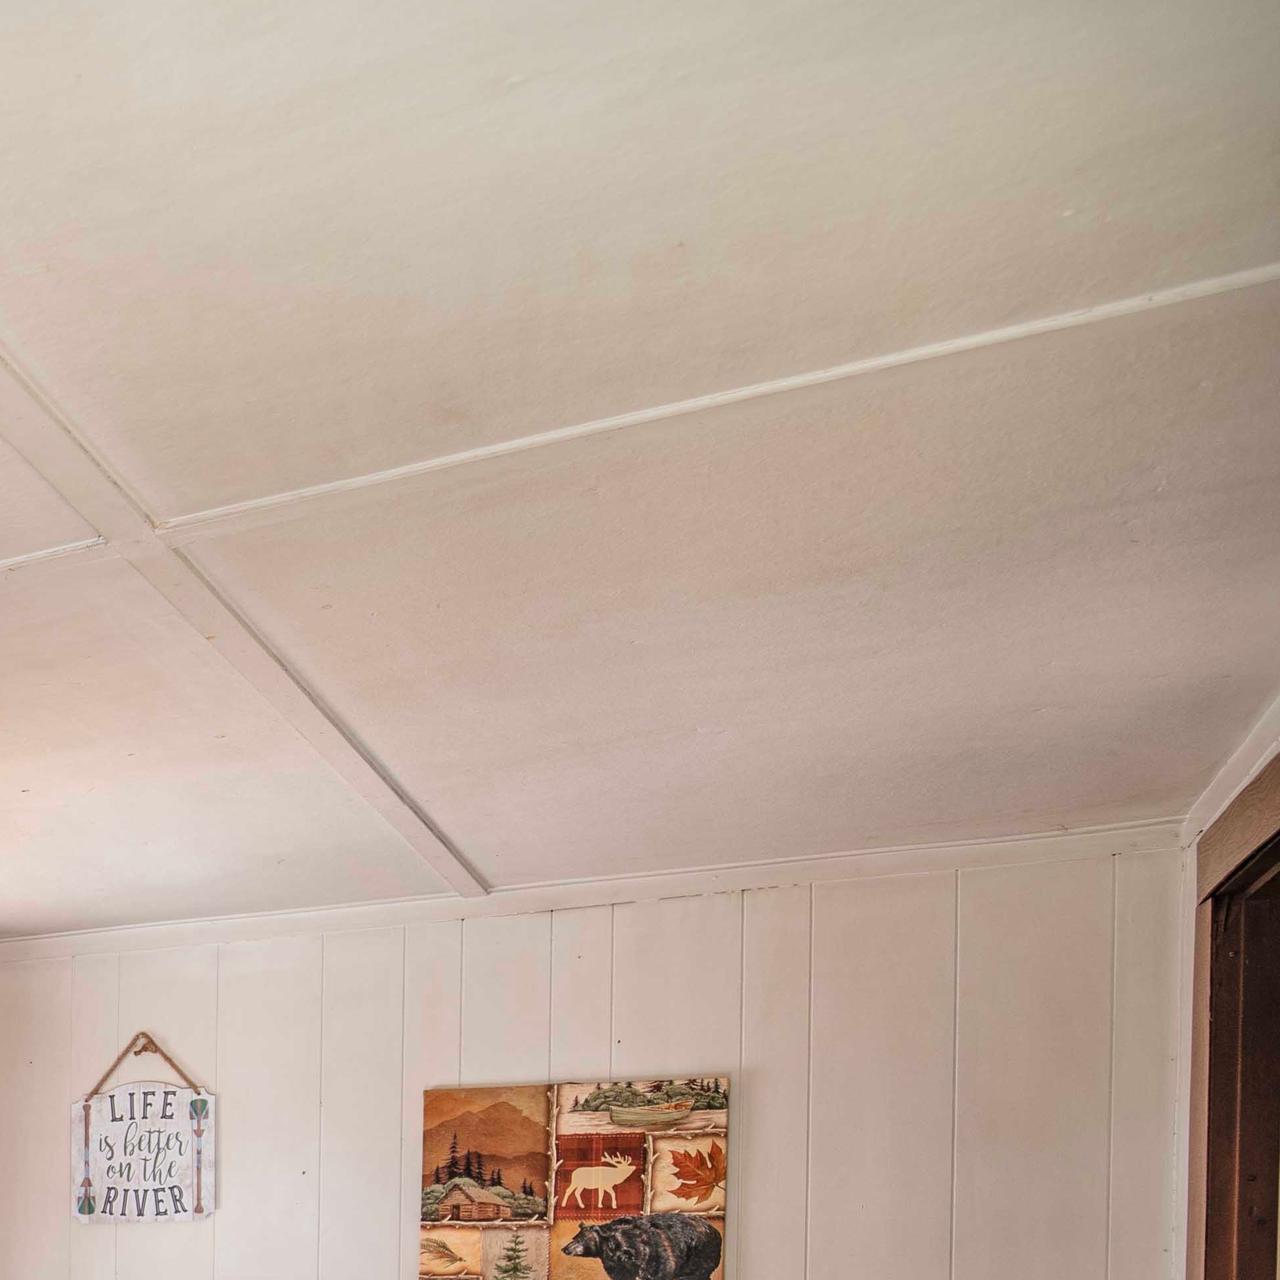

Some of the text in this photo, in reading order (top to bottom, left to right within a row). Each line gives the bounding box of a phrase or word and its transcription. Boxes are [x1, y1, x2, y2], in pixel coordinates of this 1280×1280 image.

[109, 1091, 177, 1122] LIFE
[99, 1121, 189, 1160] is better
[107, 1148, 179, 1185] on the
[100, 1185, 188, 1217] RIVER
